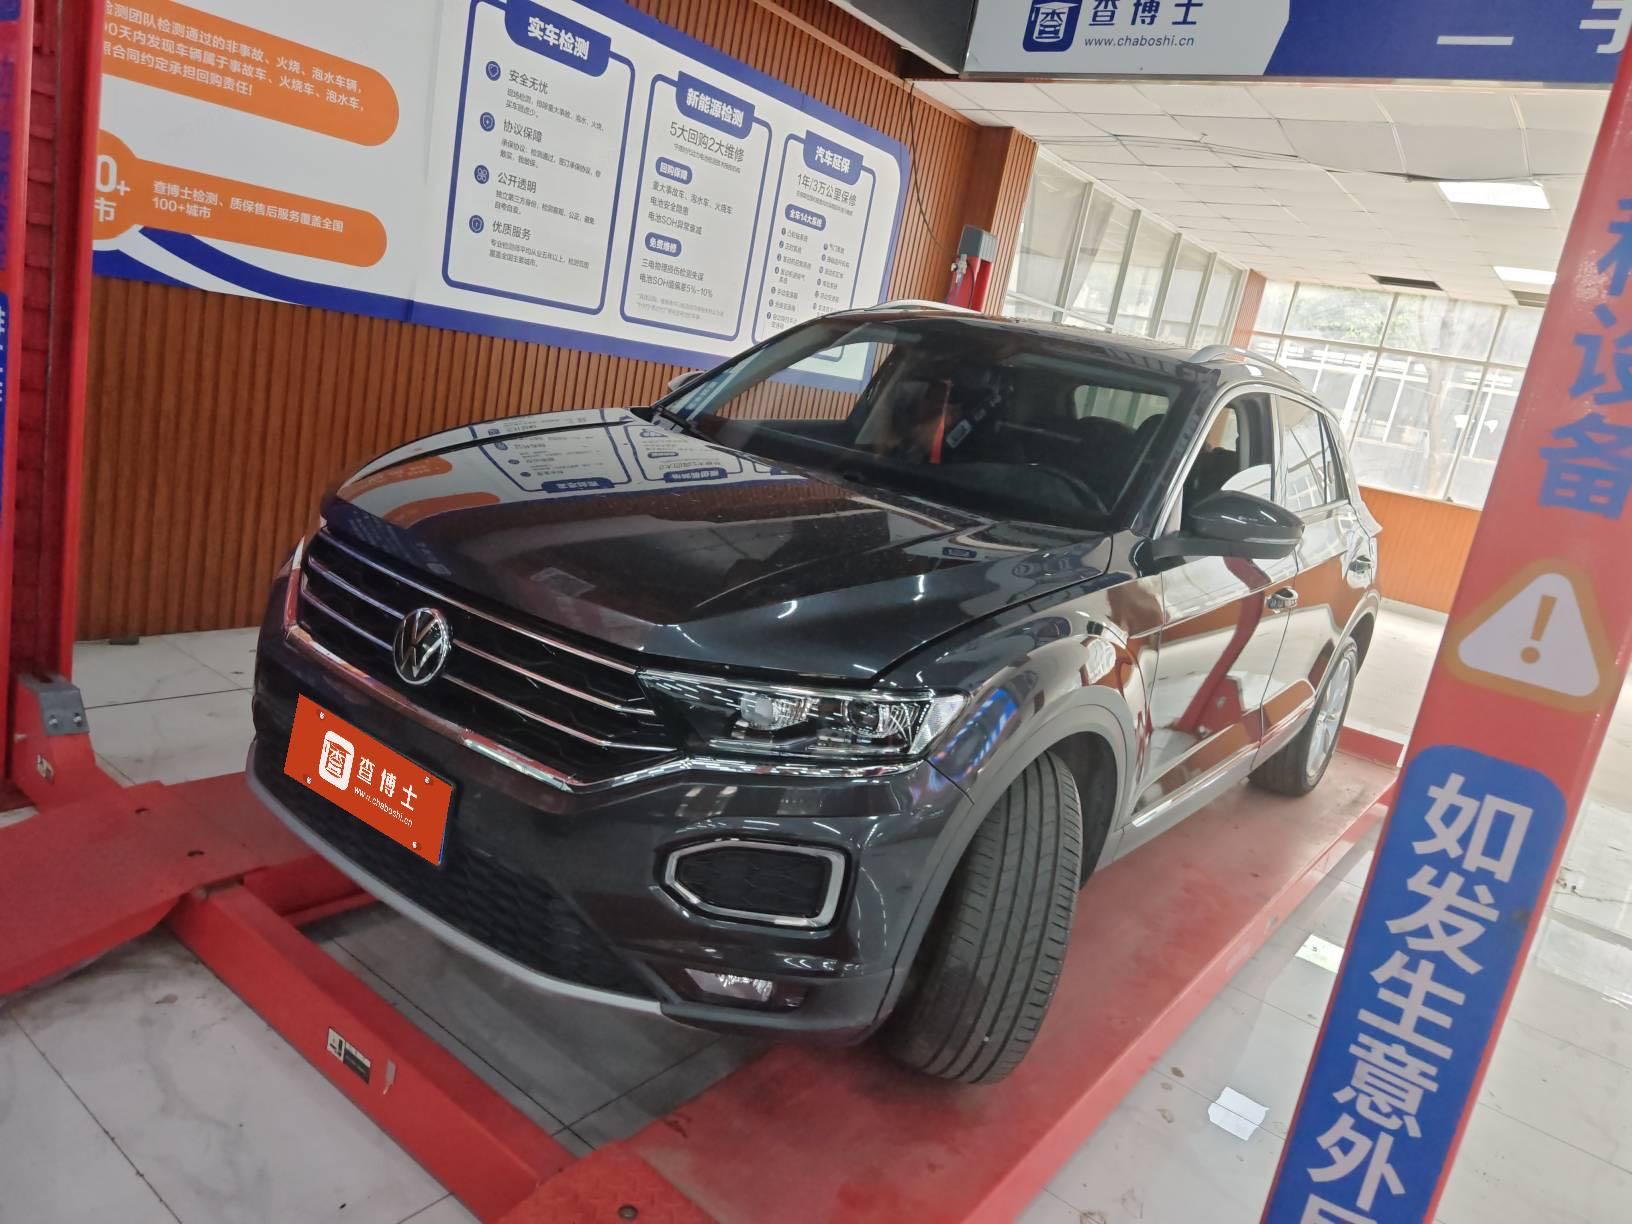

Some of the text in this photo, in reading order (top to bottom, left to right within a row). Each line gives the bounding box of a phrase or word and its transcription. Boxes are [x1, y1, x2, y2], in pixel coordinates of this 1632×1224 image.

[528, 16, 590, 60] 实车检测
[1084, 35, 1195, 47] www.chaboshi.cn
[509, 69, 549, 95] 安全无忧
[686, 88, 744, 128] 新能源检测
[503, 119, 543, 143] 协议保障
[670, 121, 745, 162] 5大回购2大维修
[815, 145, 851, 174] 汽车延保
[497, 171, 537, 194] 公开透明
[797, 173, 857, 207] 1年/3万公里保修
[153, 197, 212, 219] 100+城市
[492, 220, 532, 240] 优质服务
